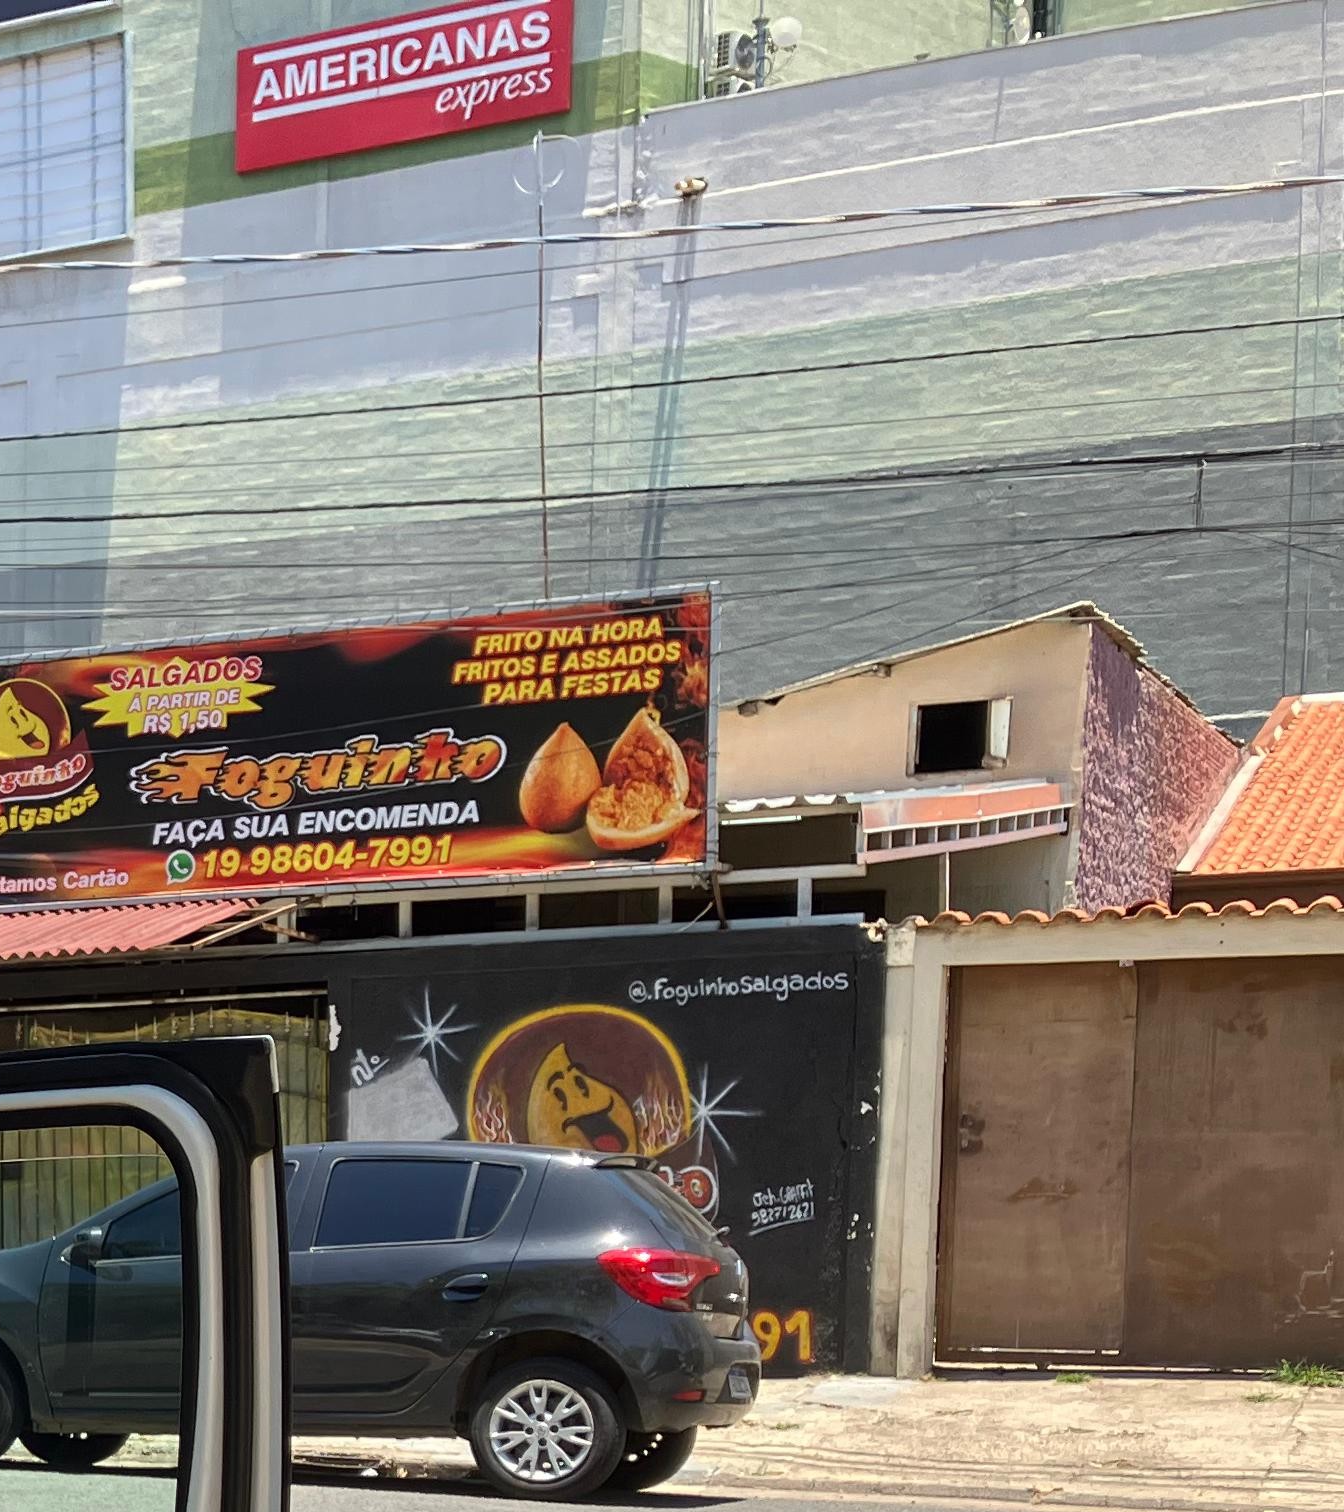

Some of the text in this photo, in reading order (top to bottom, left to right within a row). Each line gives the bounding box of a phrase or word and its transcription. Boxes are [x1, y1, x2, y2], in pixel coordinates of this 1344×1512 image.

[253, 11, 551, 106] AMERICANAS
[435, 68, 552, 120] express
[473, 615, 662, 656] FRITO NA HORA
[110, 655, 263, 691] SALGADOS
[452, 640, 682, 684] FRITOS E ASSADOS
[147, 691, 210, 711] PARTIR
[216, 689, 241, 705] DE
[483, 668, 661, 705] PARA FESTAS
[144, 711, 223, 734] R$ 1,50
[129, 728, 508, 813] Foguinho
[153, 799, 479, 848] FAÇA SUA ENCOMENDA
[202, 833, 453, 879] 19 98604-7991
[64, 869, 129, 889] Cartão
